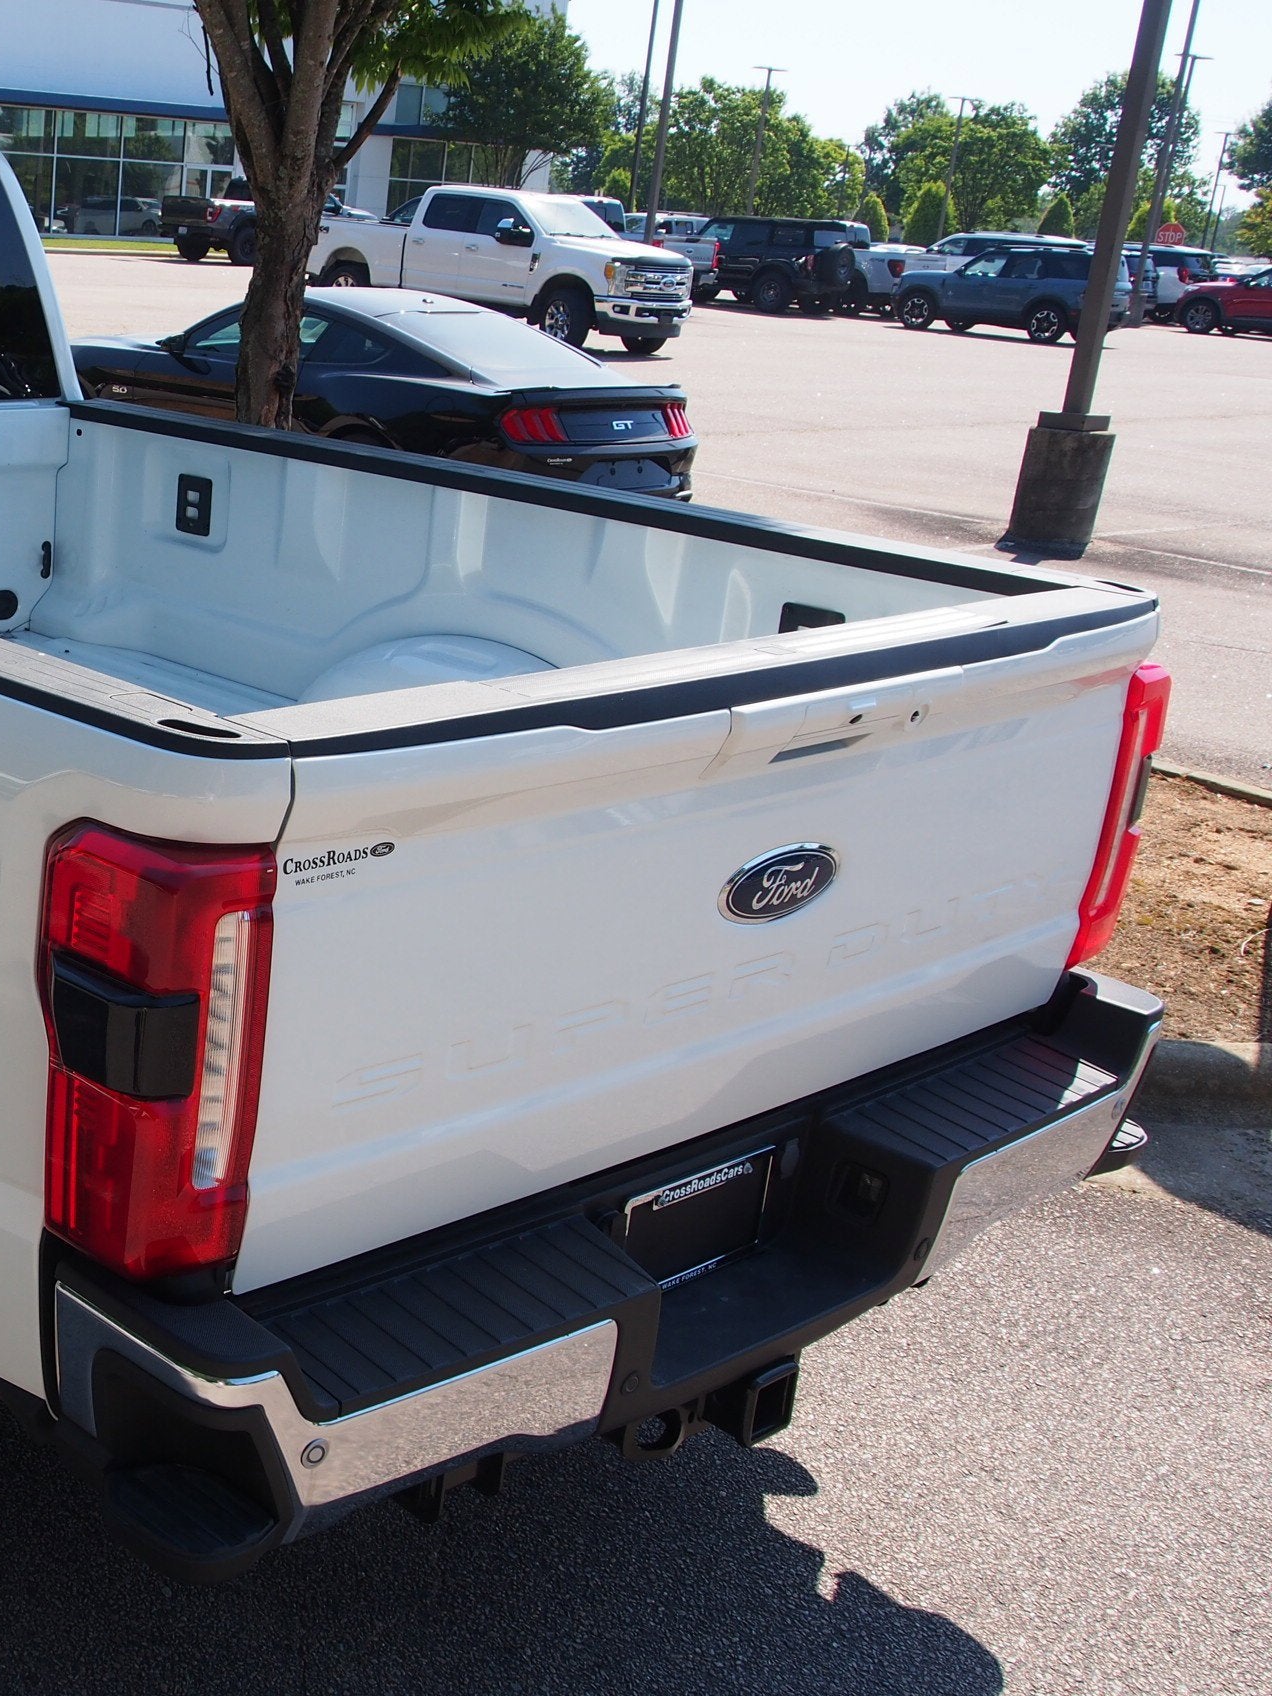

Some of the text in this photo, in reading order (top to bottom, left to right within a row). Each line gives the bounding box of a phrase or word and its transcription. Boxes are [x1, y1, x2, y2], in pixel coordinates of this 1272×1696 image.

[1157, 231, 1183, 243] STOP
[612, 420, 634, 430] GT
[294, 868, 356, 887] WAKE FOREST, NC
[750, 860, 820, 911] Ford
[330, 949, 798, 1114] SUPER
[662, 1163, 744, 1203] CrossRoadsCars
[662, 1277, 680, 1290] WAKE
[708, 1262, 718, 1270] NC
